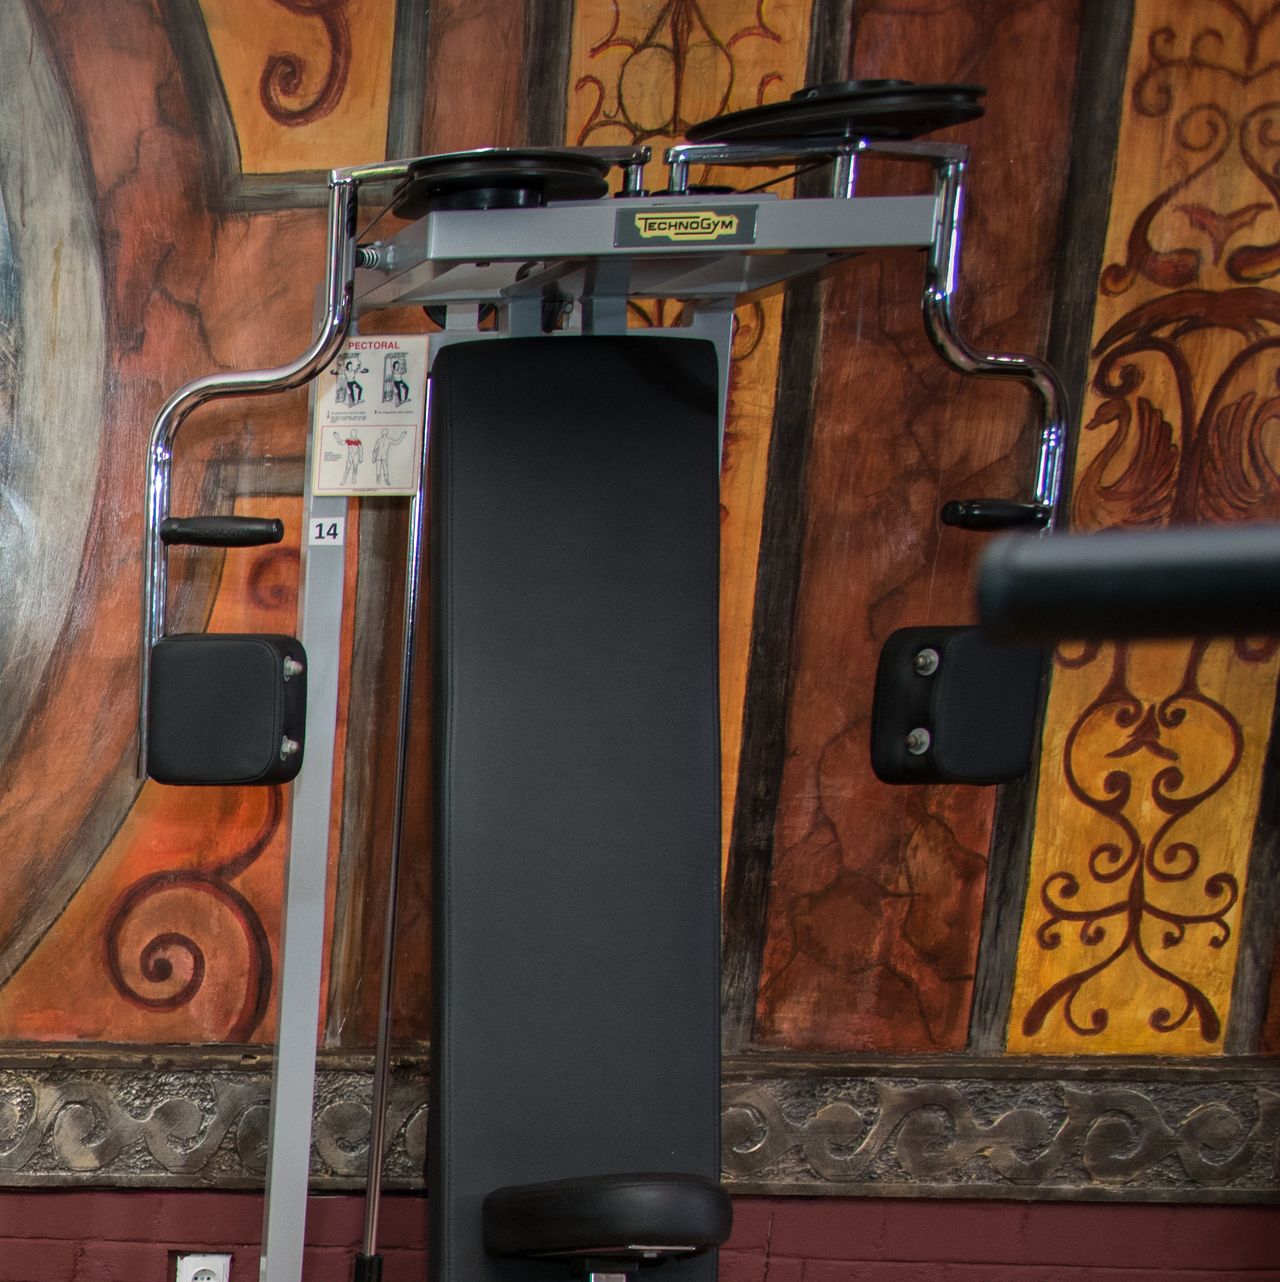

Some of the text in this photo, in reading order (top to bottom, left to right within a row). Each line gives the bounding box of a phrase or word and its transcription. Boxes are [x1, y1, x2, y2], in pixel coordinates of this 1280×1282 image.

[637, 216, 734, 236] TECHNOGYM
[348, 340, 401, 350] PECTORAL
[314, 522, 339, 540] 14
